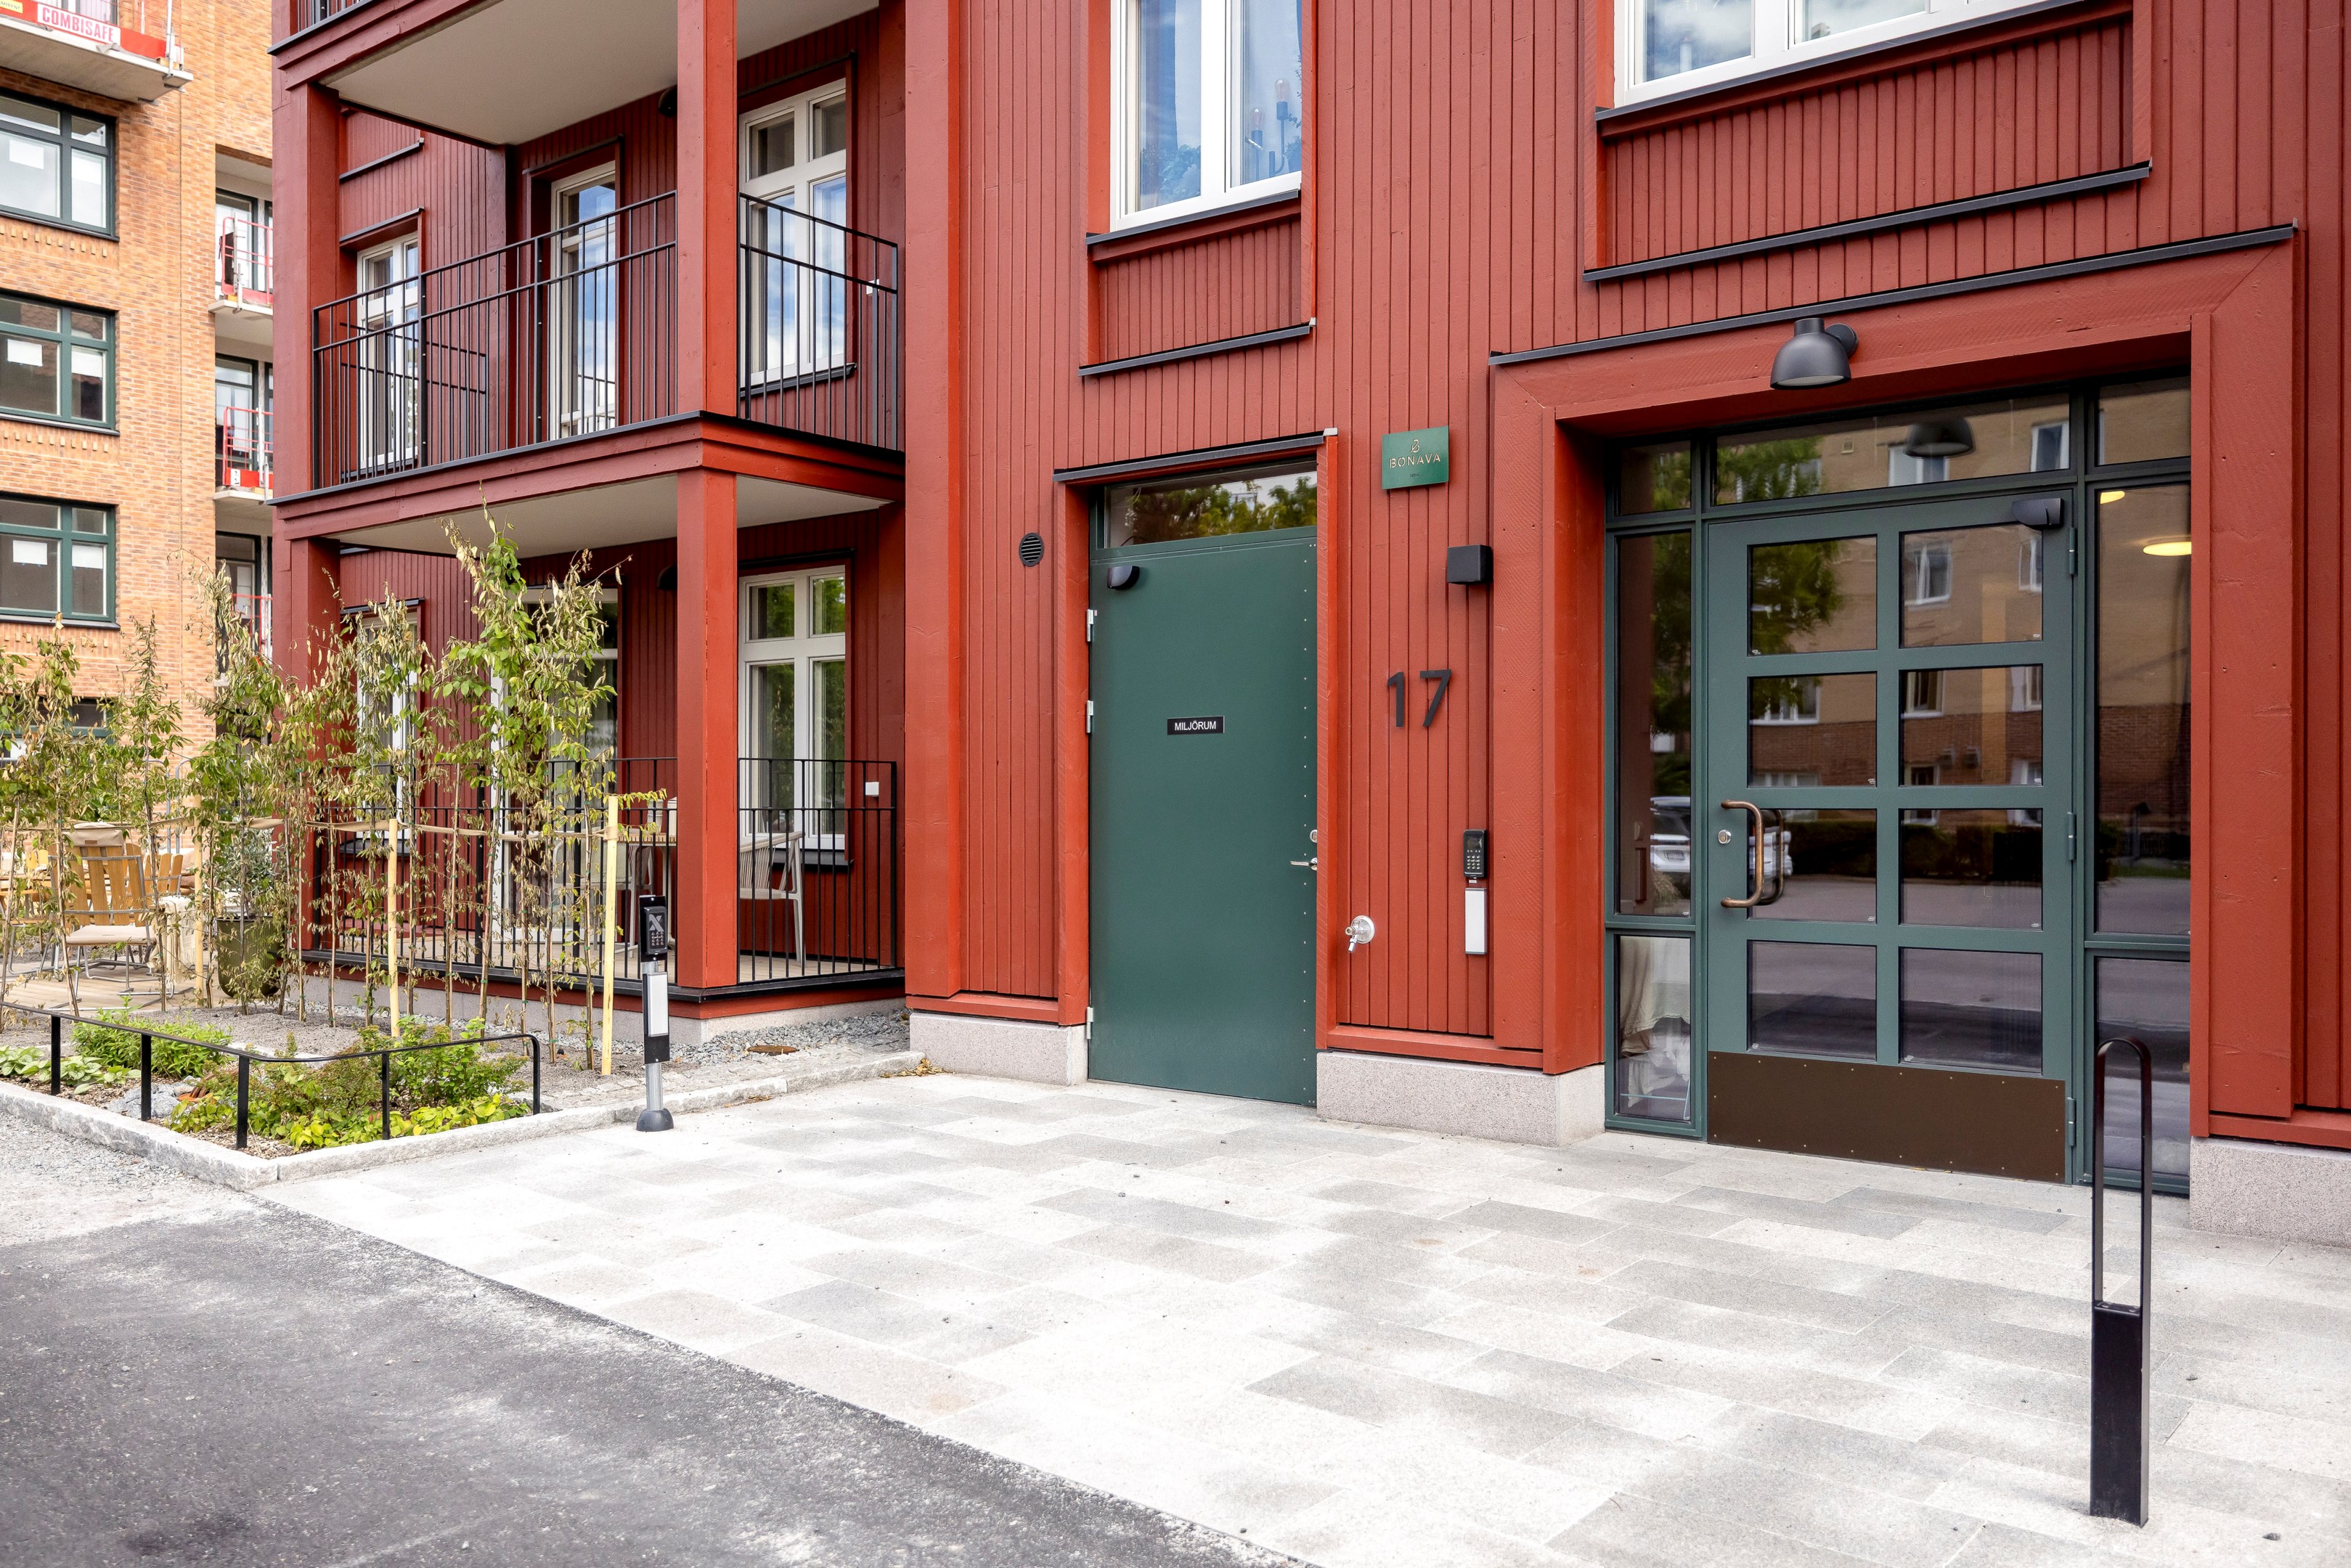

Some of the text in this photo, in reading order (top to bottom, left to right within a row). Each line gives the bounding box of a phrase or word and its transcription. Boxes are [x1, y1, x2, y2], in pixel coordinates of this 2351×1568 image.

[42, 7, 114, 43] COMBISAFE
[1389, 452, 1441, 468] BONAVA
[1387, 669, 1452, 727] 17
[1174, 720, 1217, 731] MILJÖRUM
